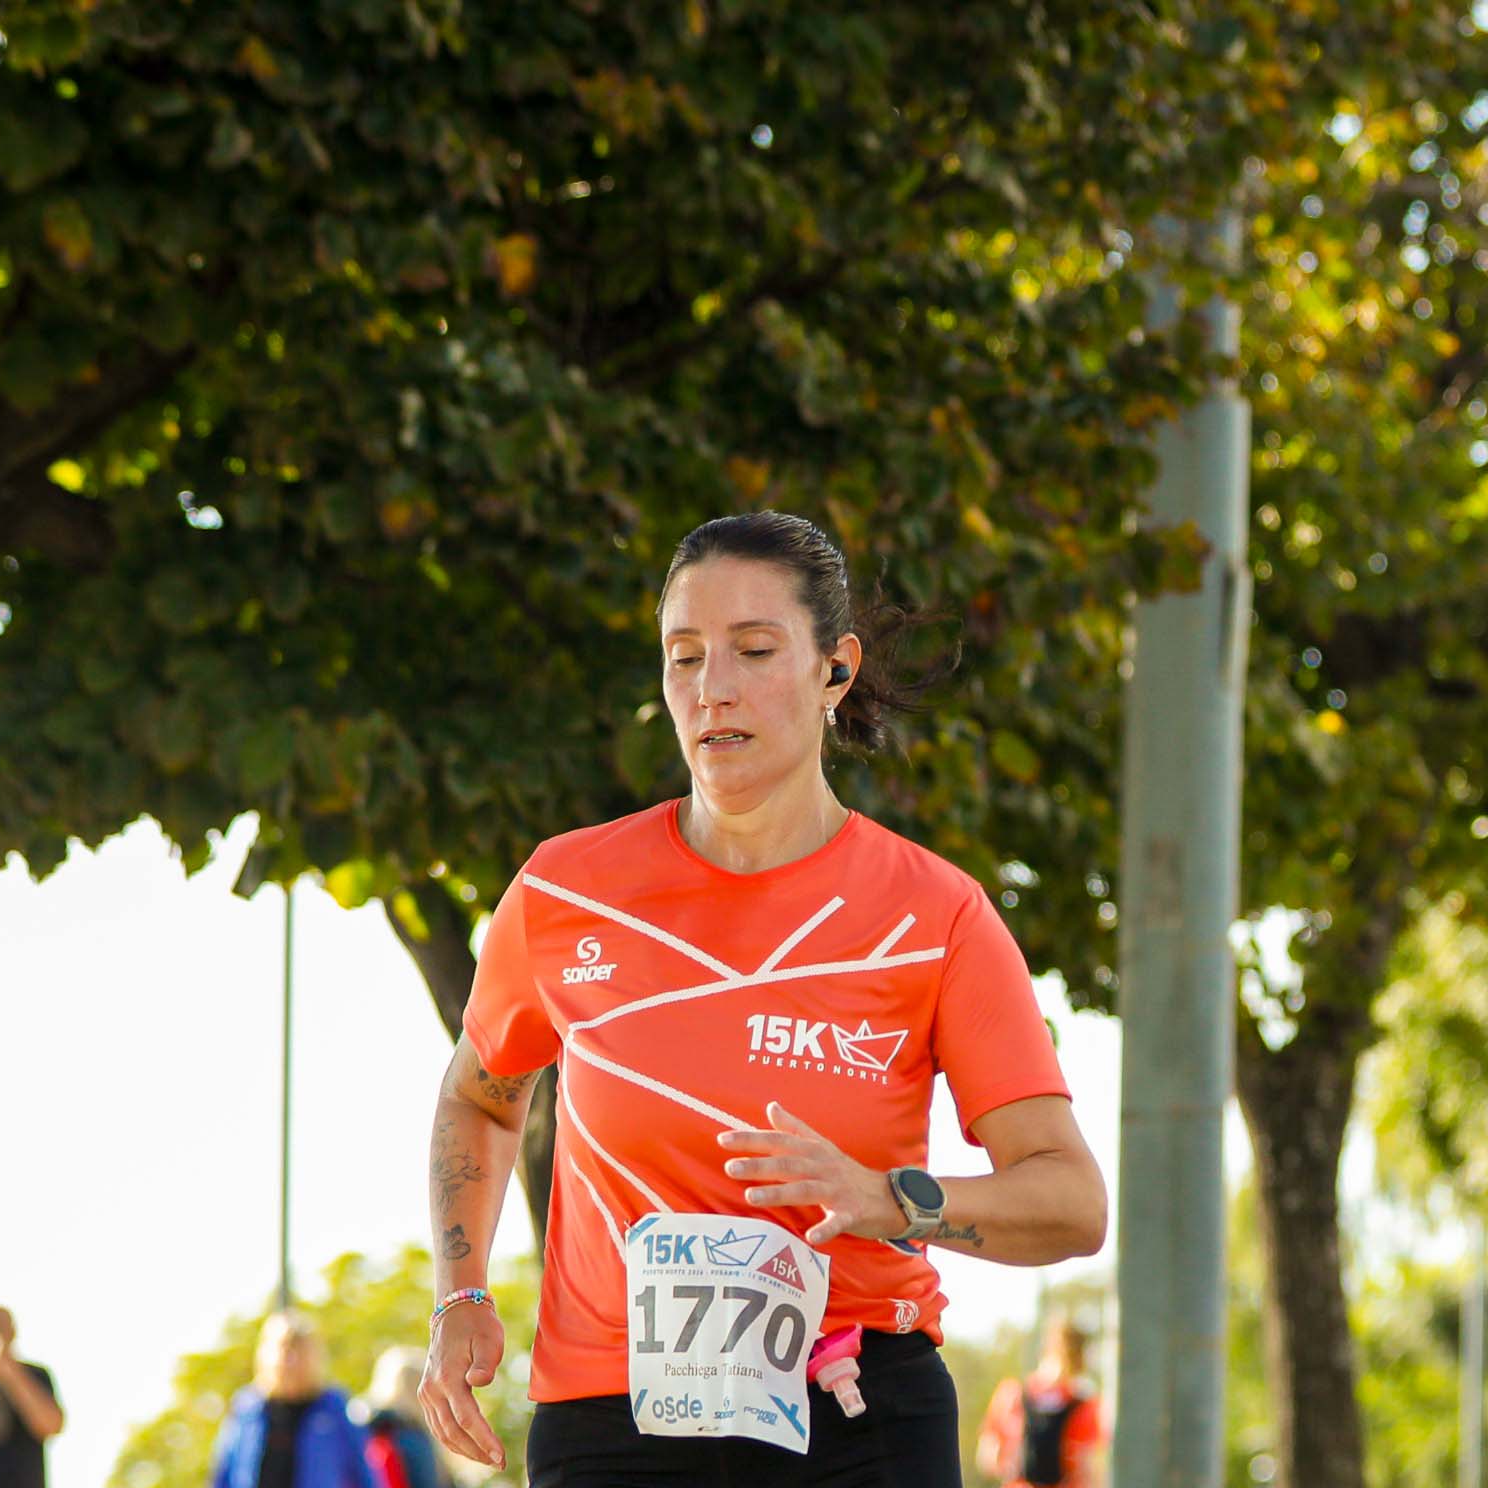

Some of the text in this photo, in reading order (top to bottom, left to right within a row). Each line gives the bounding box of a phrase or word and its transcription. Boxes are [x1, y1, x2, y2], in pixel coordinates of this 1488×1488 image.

[746, 1014, 829, 1059] 15K
[748, 1054, 889, 1085] PUERTO NORTE
[643, 1234, 697, 1265] 15K
[770, 1256, 799, 1283] 15K
[635, 1285, 806, 1373] 1770
